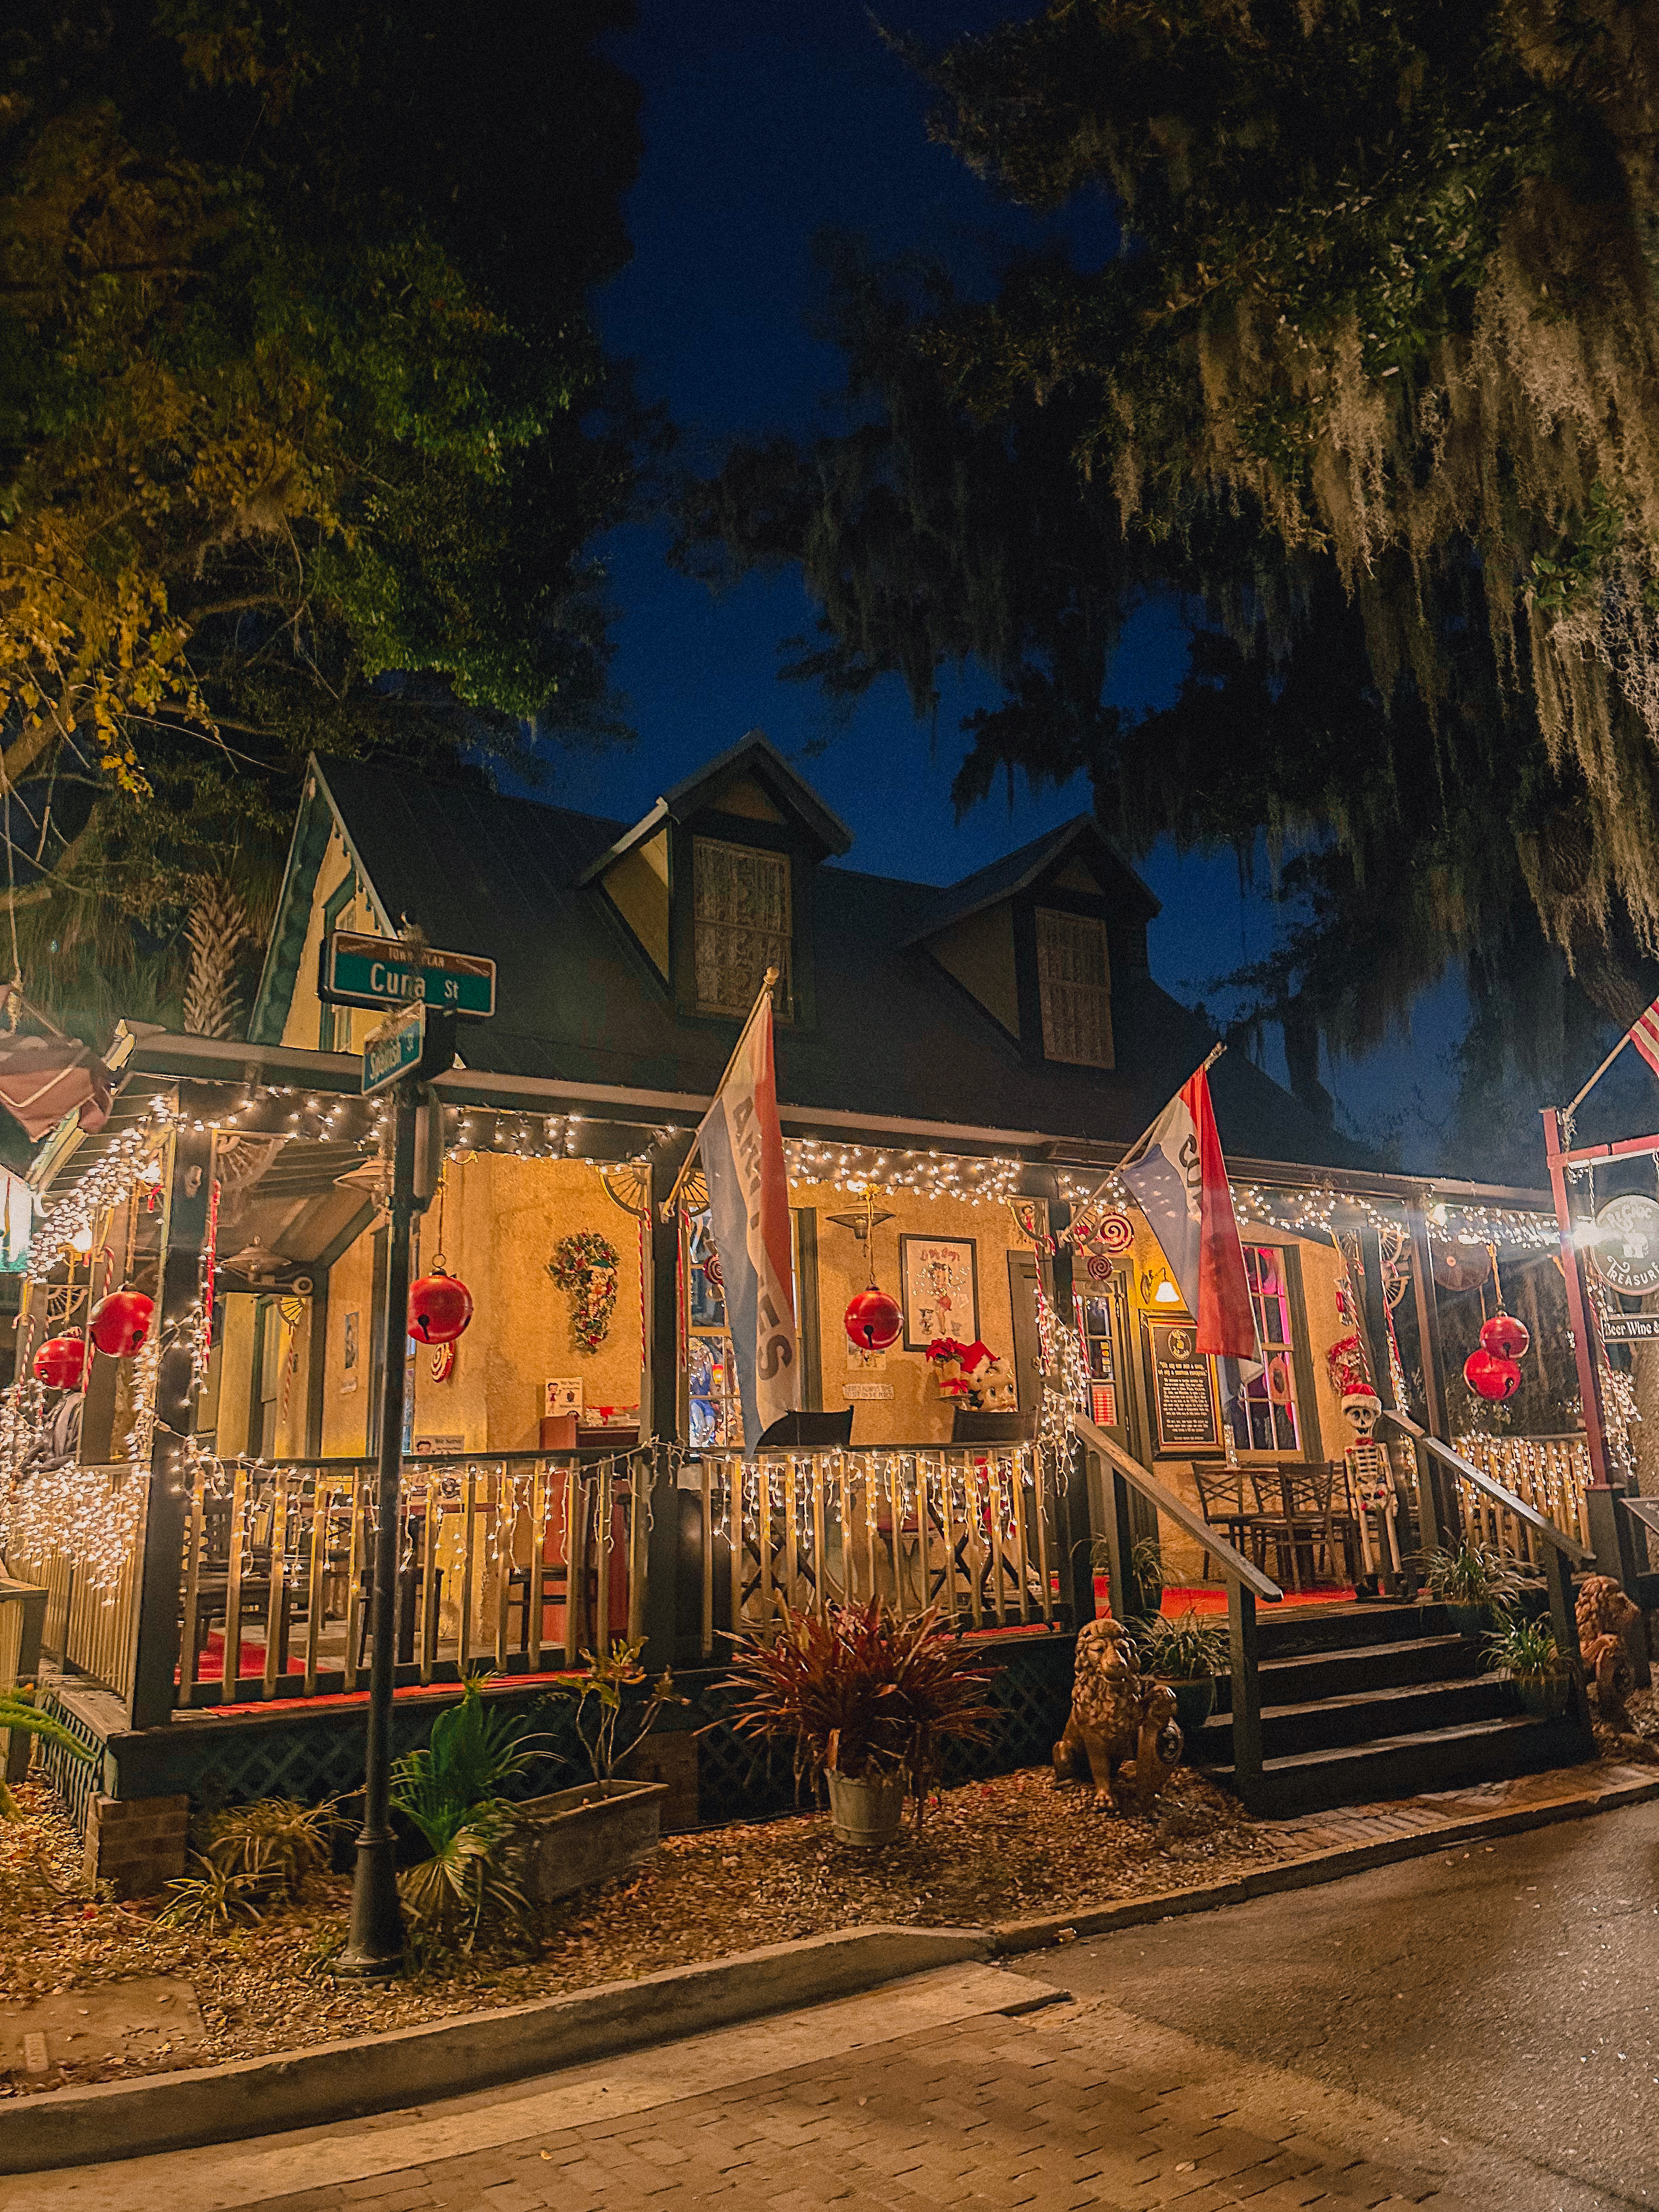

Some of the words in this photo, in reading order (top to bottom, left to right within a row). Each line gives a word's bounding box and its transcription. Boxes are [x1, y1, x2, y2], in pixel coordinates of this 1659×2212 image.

[370, 962, 426, 998] Cuna
[444, 979, 459, 1000] St
[1603, 1322, 1626, 1336] Beer
[1626, 1321, 1652, 1336] Wine
